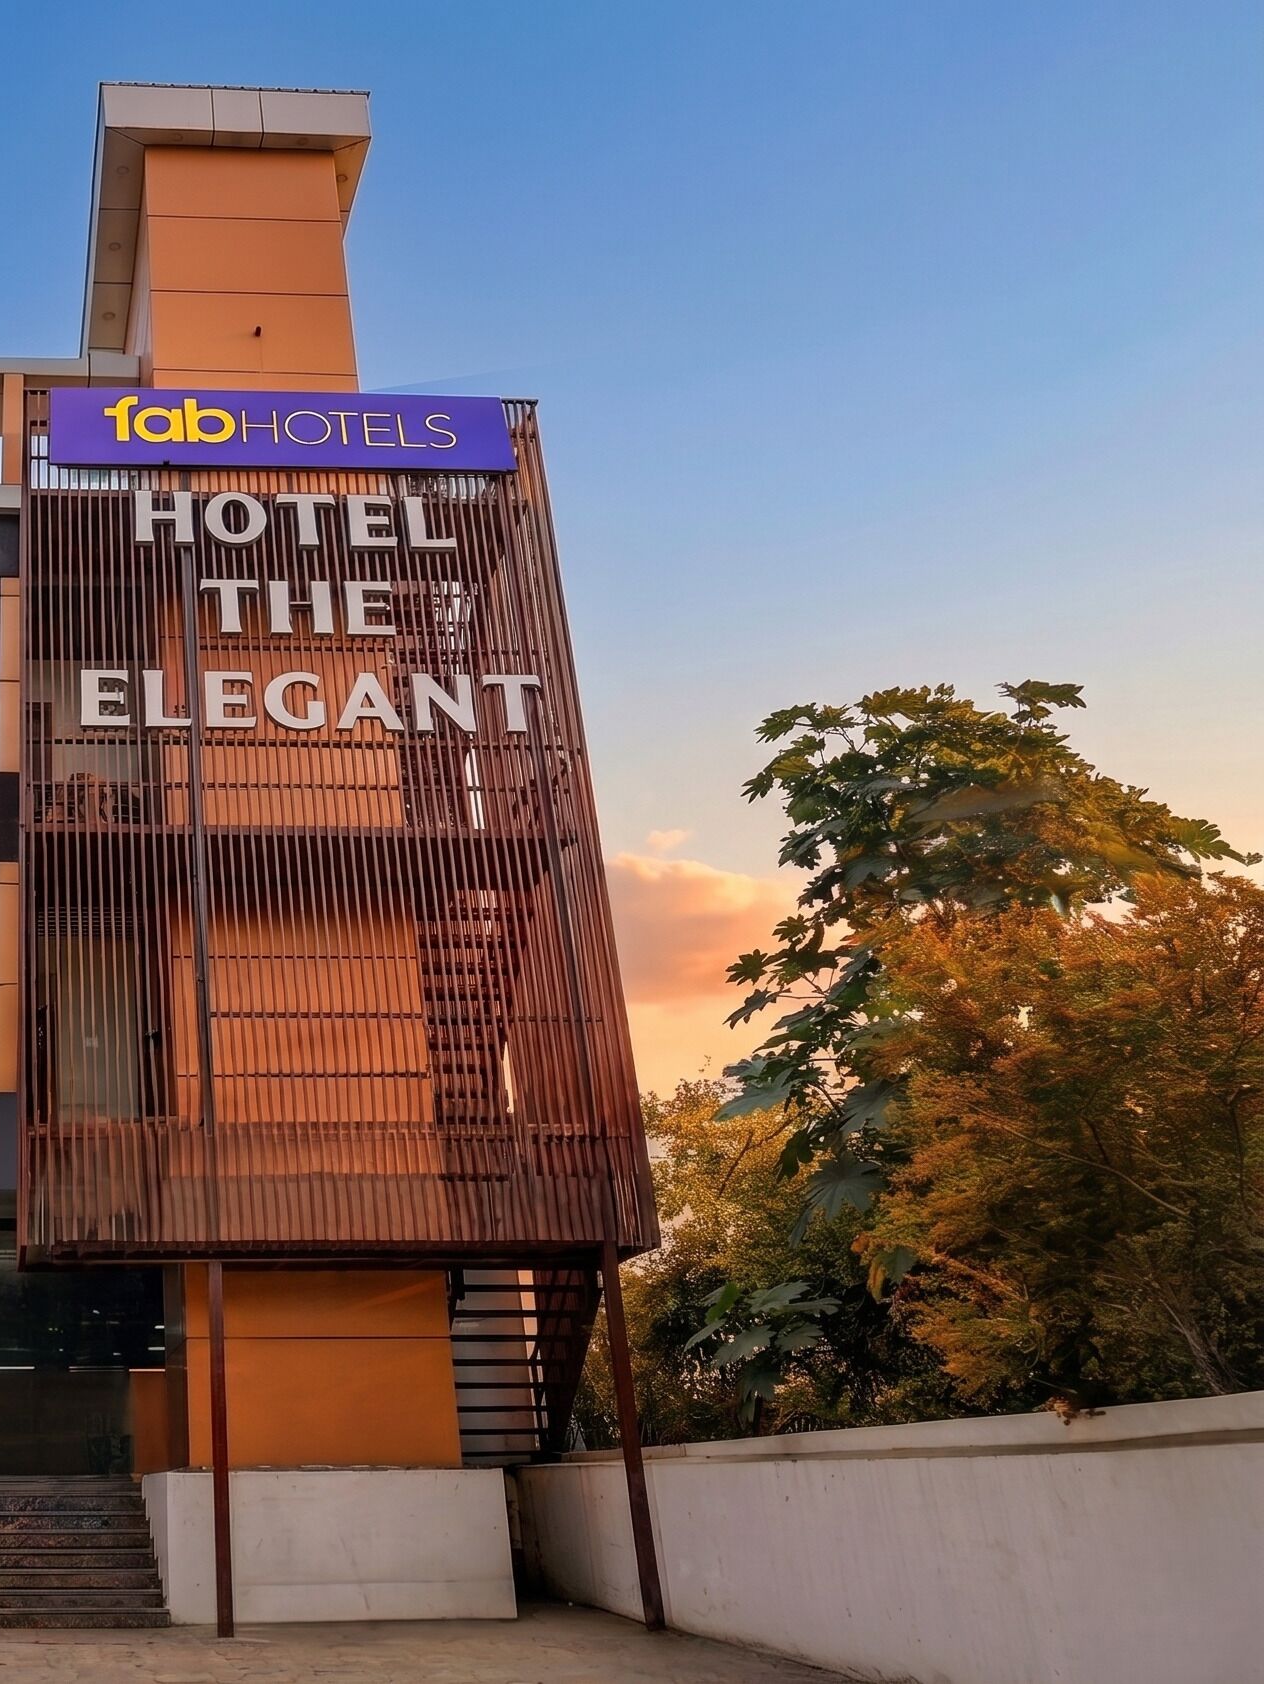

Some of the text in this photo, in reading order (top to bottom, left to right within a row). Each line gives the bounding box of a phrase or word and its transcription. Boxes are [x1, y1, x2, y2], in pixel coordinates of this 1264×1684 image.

[135, 490, 457, 552] HOTEL
[200, 578, 397, 637] THE
[80, 668, 541, 734] ELEGANT
